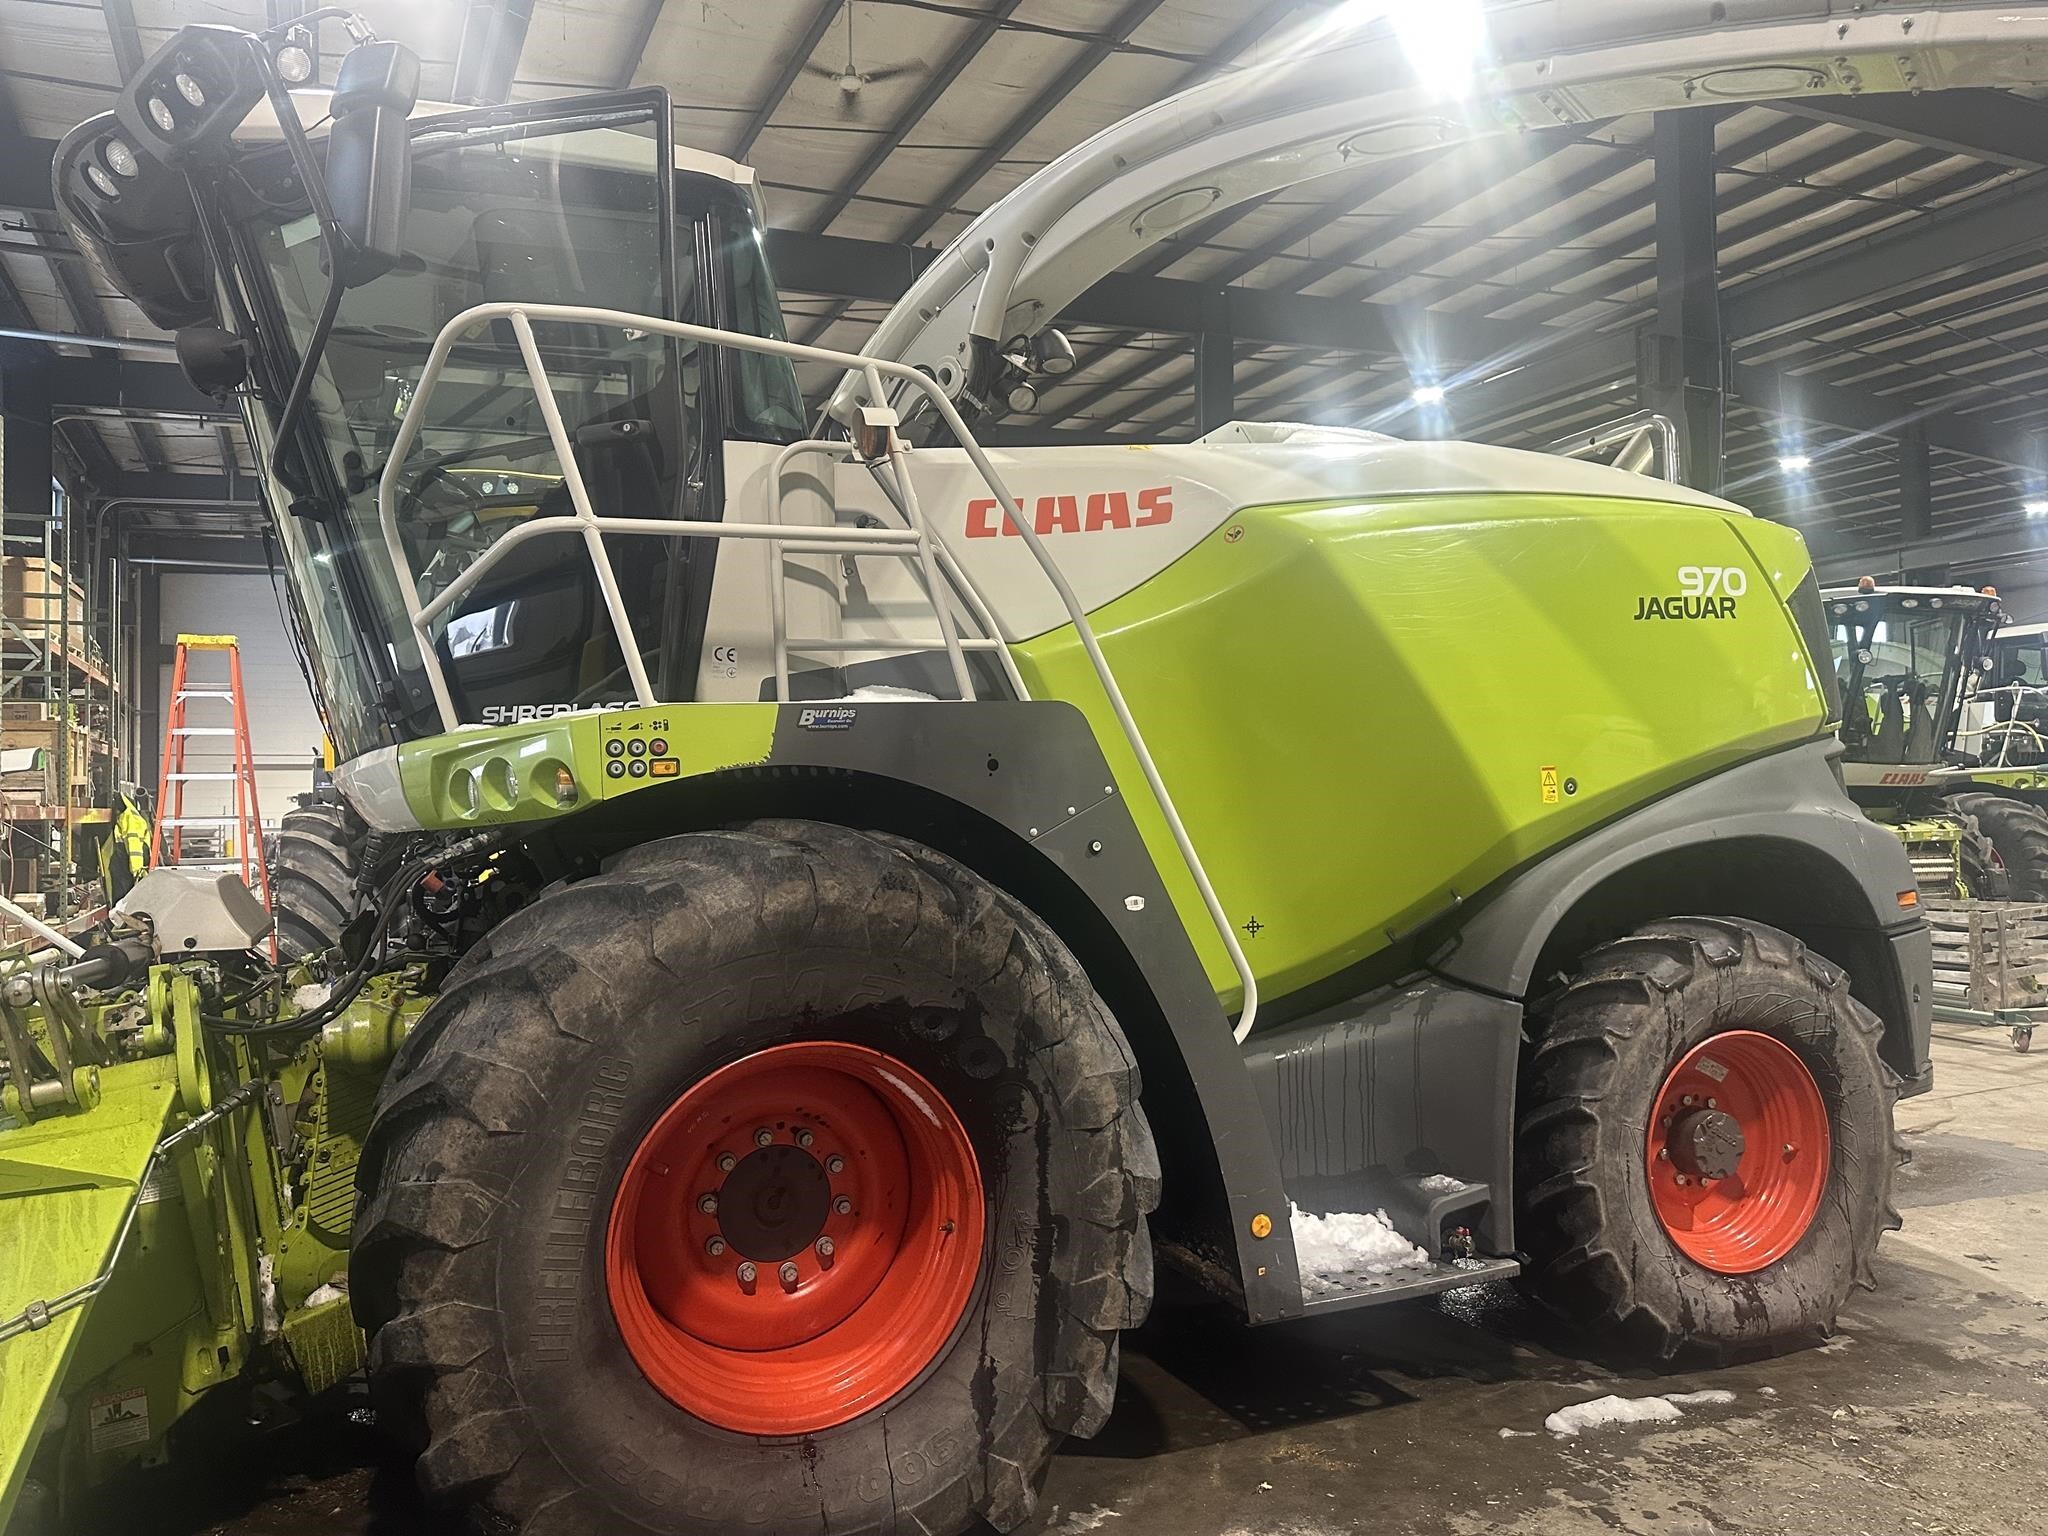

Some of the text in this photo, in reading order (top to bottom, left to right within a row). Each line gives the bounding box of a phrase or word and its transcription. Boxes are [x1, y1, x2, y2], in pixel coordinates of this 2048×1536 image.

[965, 486, 1173, 538] CLAAS
[1678, 566, 1746, 596] 970
[1634, 596, 1736, 620] JAGUAR
[714, 647, 736, 662] CE
[799, 707, 856, 725] Burnips
[1879, 773, 1927, 784] CLAAS
[523, 1055, 634, 1372] TRELLEBORG
